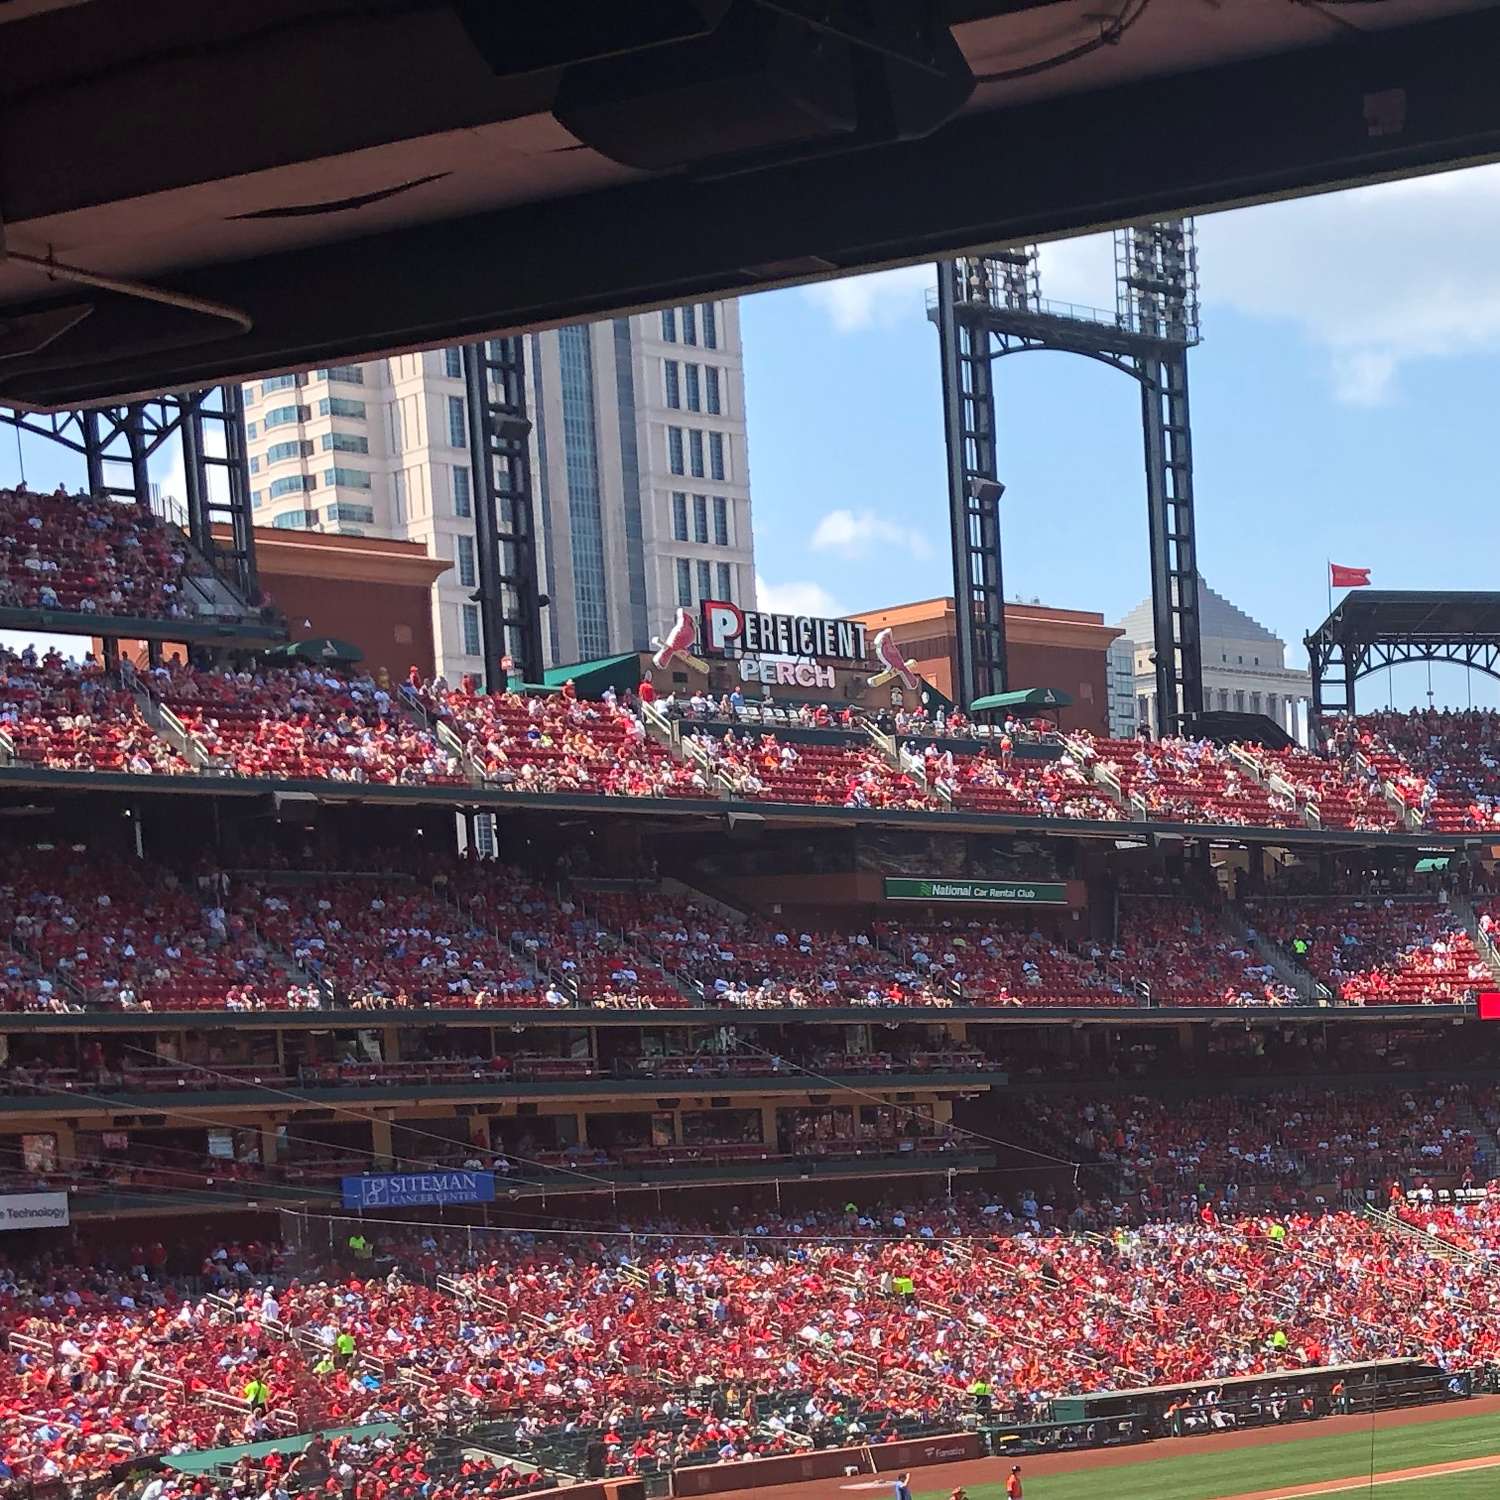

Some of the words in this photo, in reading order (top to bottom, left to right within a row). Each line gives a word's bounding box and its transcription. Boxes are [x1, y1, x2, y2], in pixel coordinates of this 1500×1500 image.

[740, 659, 835, 689] PERCH
[932, 884, 971, 896] National
[974, 887, 988, 897] Car
[990, 888, 1016, 898] Rental
[1017, 889, 1036, 899] Club
[390, 1173, 477, 1193] SITEMAN
[391, 1194, 434, 1205] CANCER
[436, 1191, 478, 1203] CENTER
[7, 1206, 66, 1219] Technology
